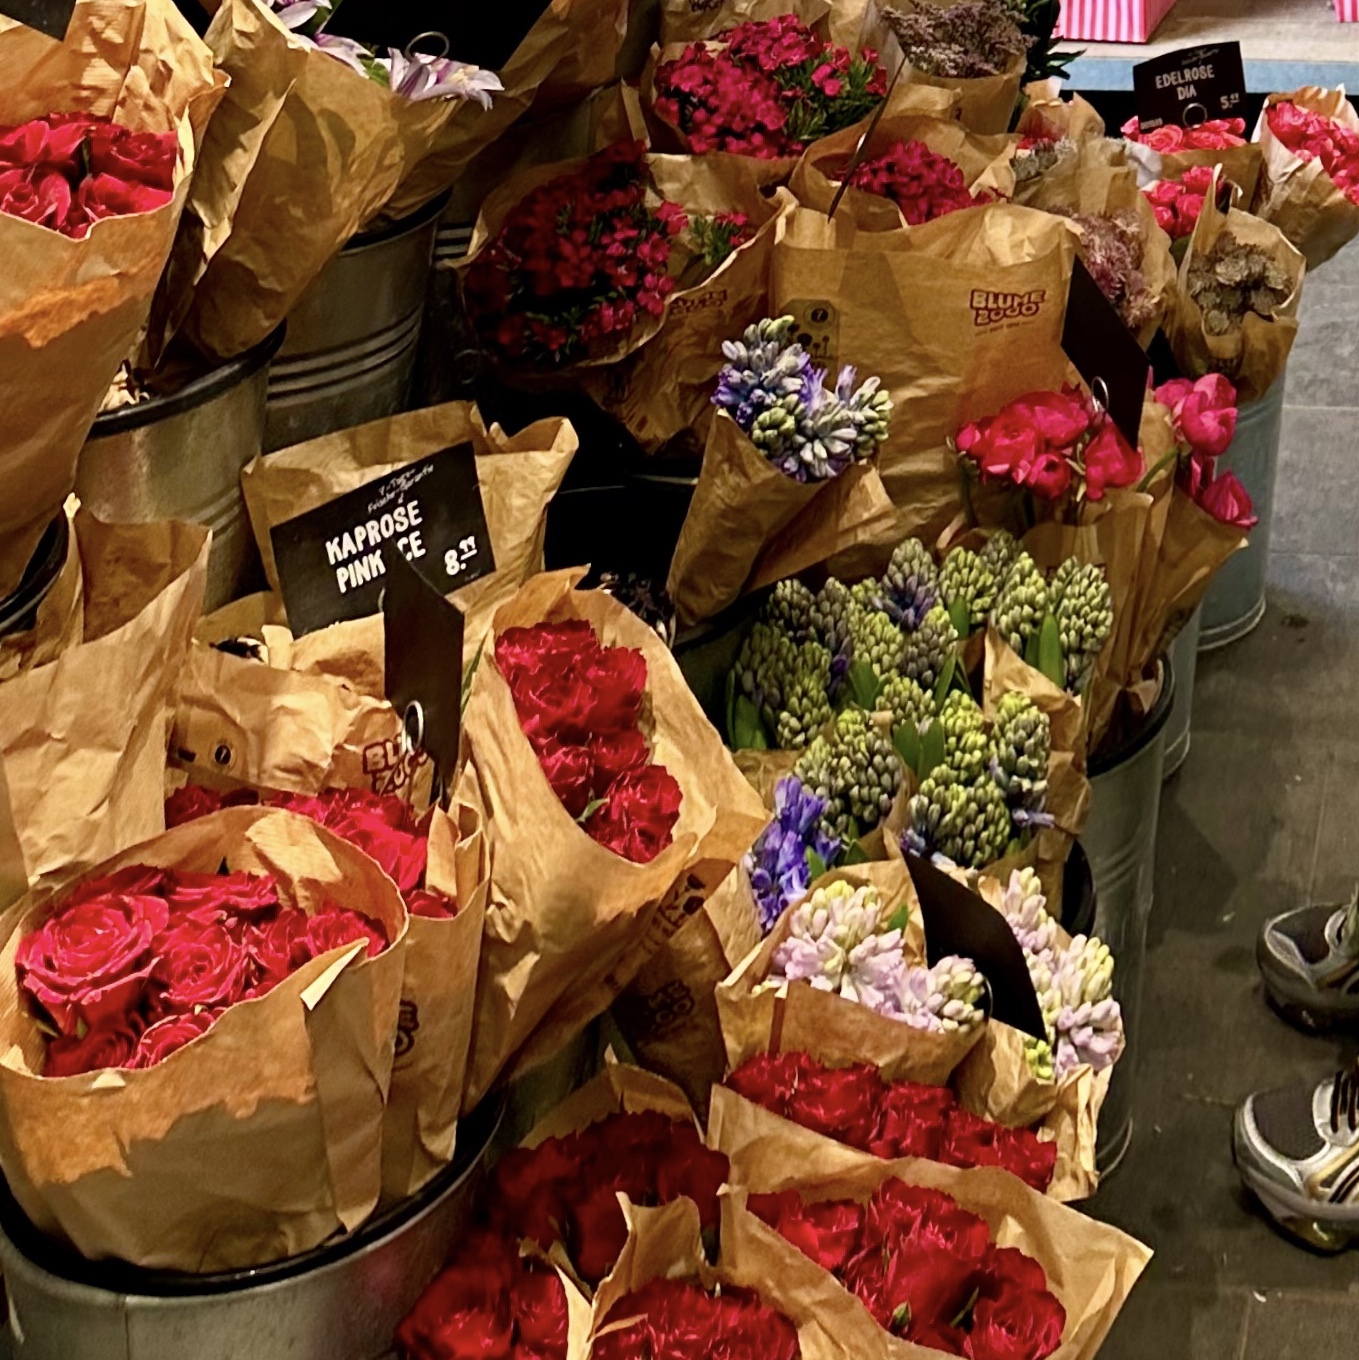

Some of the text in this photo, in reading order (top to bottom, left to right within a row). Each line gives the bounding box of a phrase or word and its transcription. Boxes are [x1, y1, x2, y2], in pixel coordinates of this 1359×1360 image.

[1155, 64, 1216, 90] EDELROSE
[1176, 84, 1198, 101] DIA
[970, 289, 1046, 310] BLUME
[325, 499, 423, 566] KAPROSE
[335, 549, 387, 594] PINK
